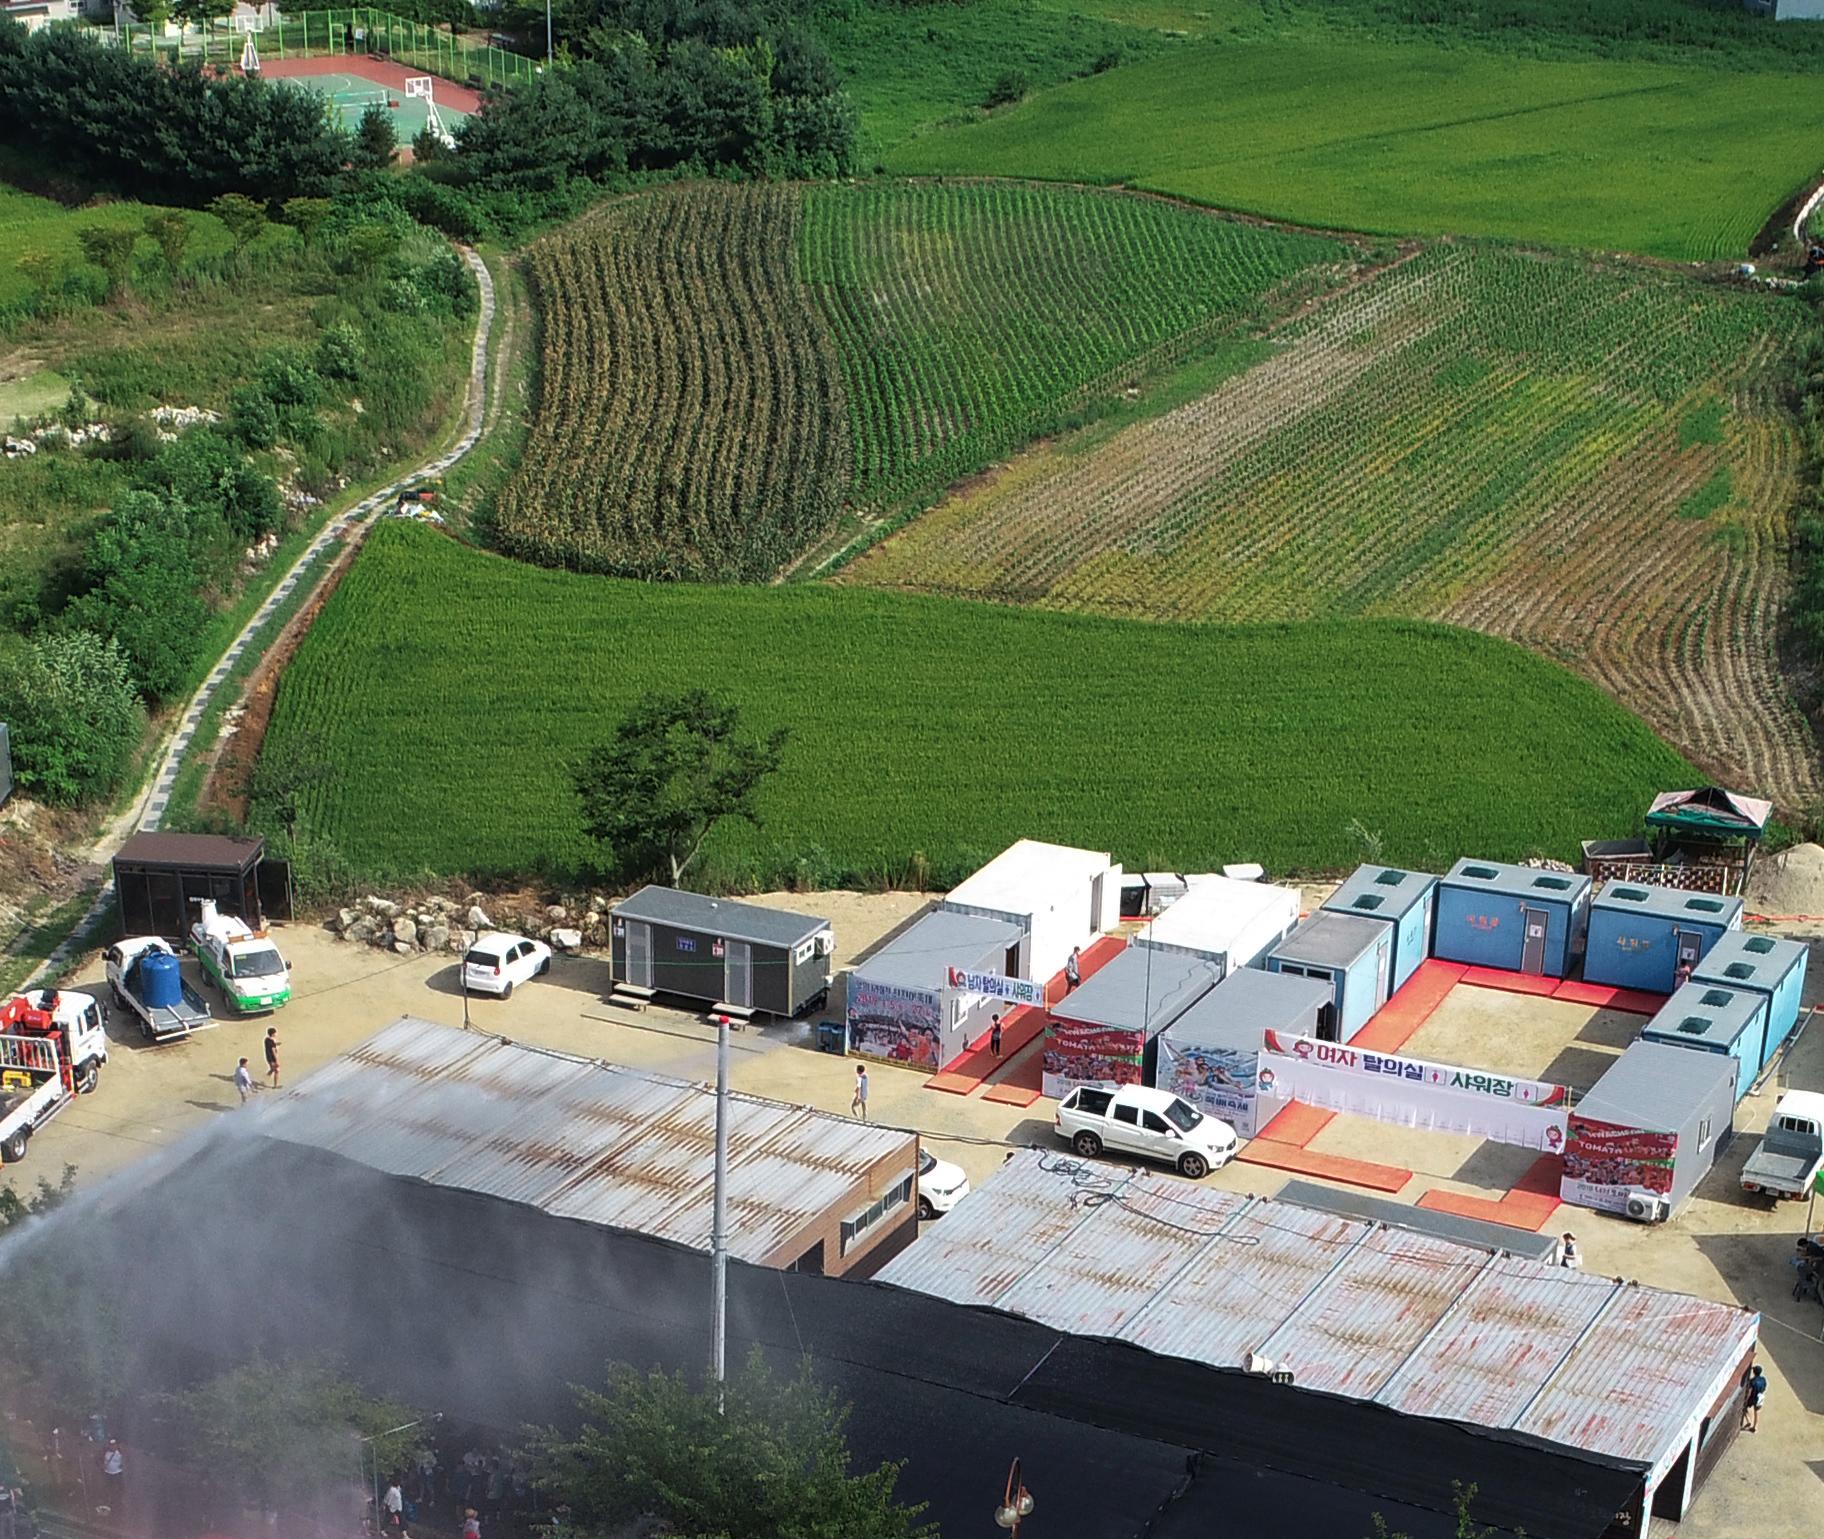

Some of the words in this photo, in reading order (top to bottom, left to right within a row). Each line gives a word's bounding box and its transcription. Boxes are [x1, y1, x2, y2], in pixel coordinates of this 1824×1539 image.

[967, 974, 982, 989] 남자
[983, 977, 1004, 996] 탈의실
[1012, 982, 1033, 1001] 샤워장
[1317, 1041, 1358, 1067] 여자
[1363, 1054, 1424, 1081] 탈의실
[1449, 1071, 1514, 1097] 샤워장
